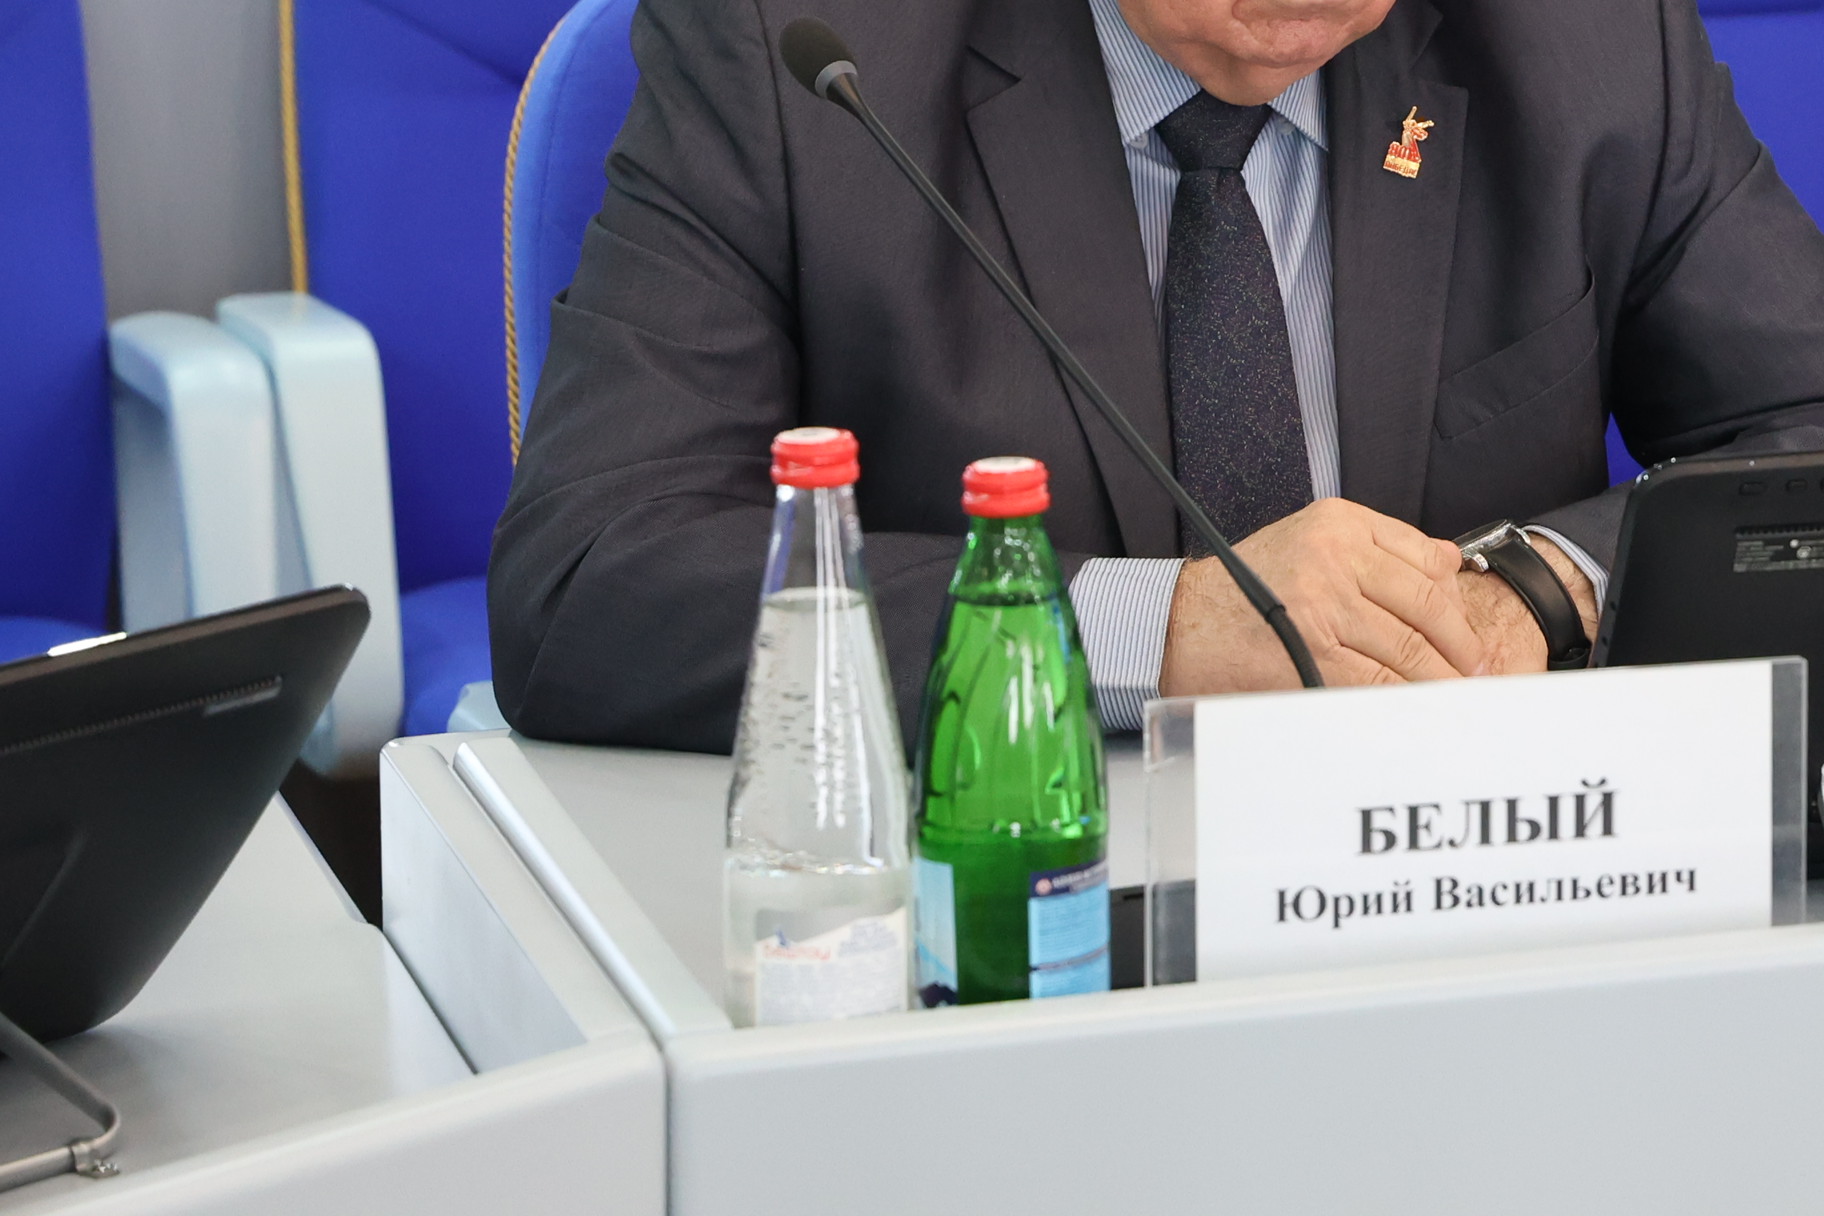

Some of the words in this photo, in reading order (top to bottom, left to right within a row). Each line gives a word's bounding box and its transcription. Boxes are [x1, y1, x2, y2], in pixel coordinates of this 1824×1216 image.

[1357, 778, 1620, 856] БЕЛЫЙ
[1276, 880, 1413, 929] Юрий
[1433, 868, 1697, 911] Васильевич
